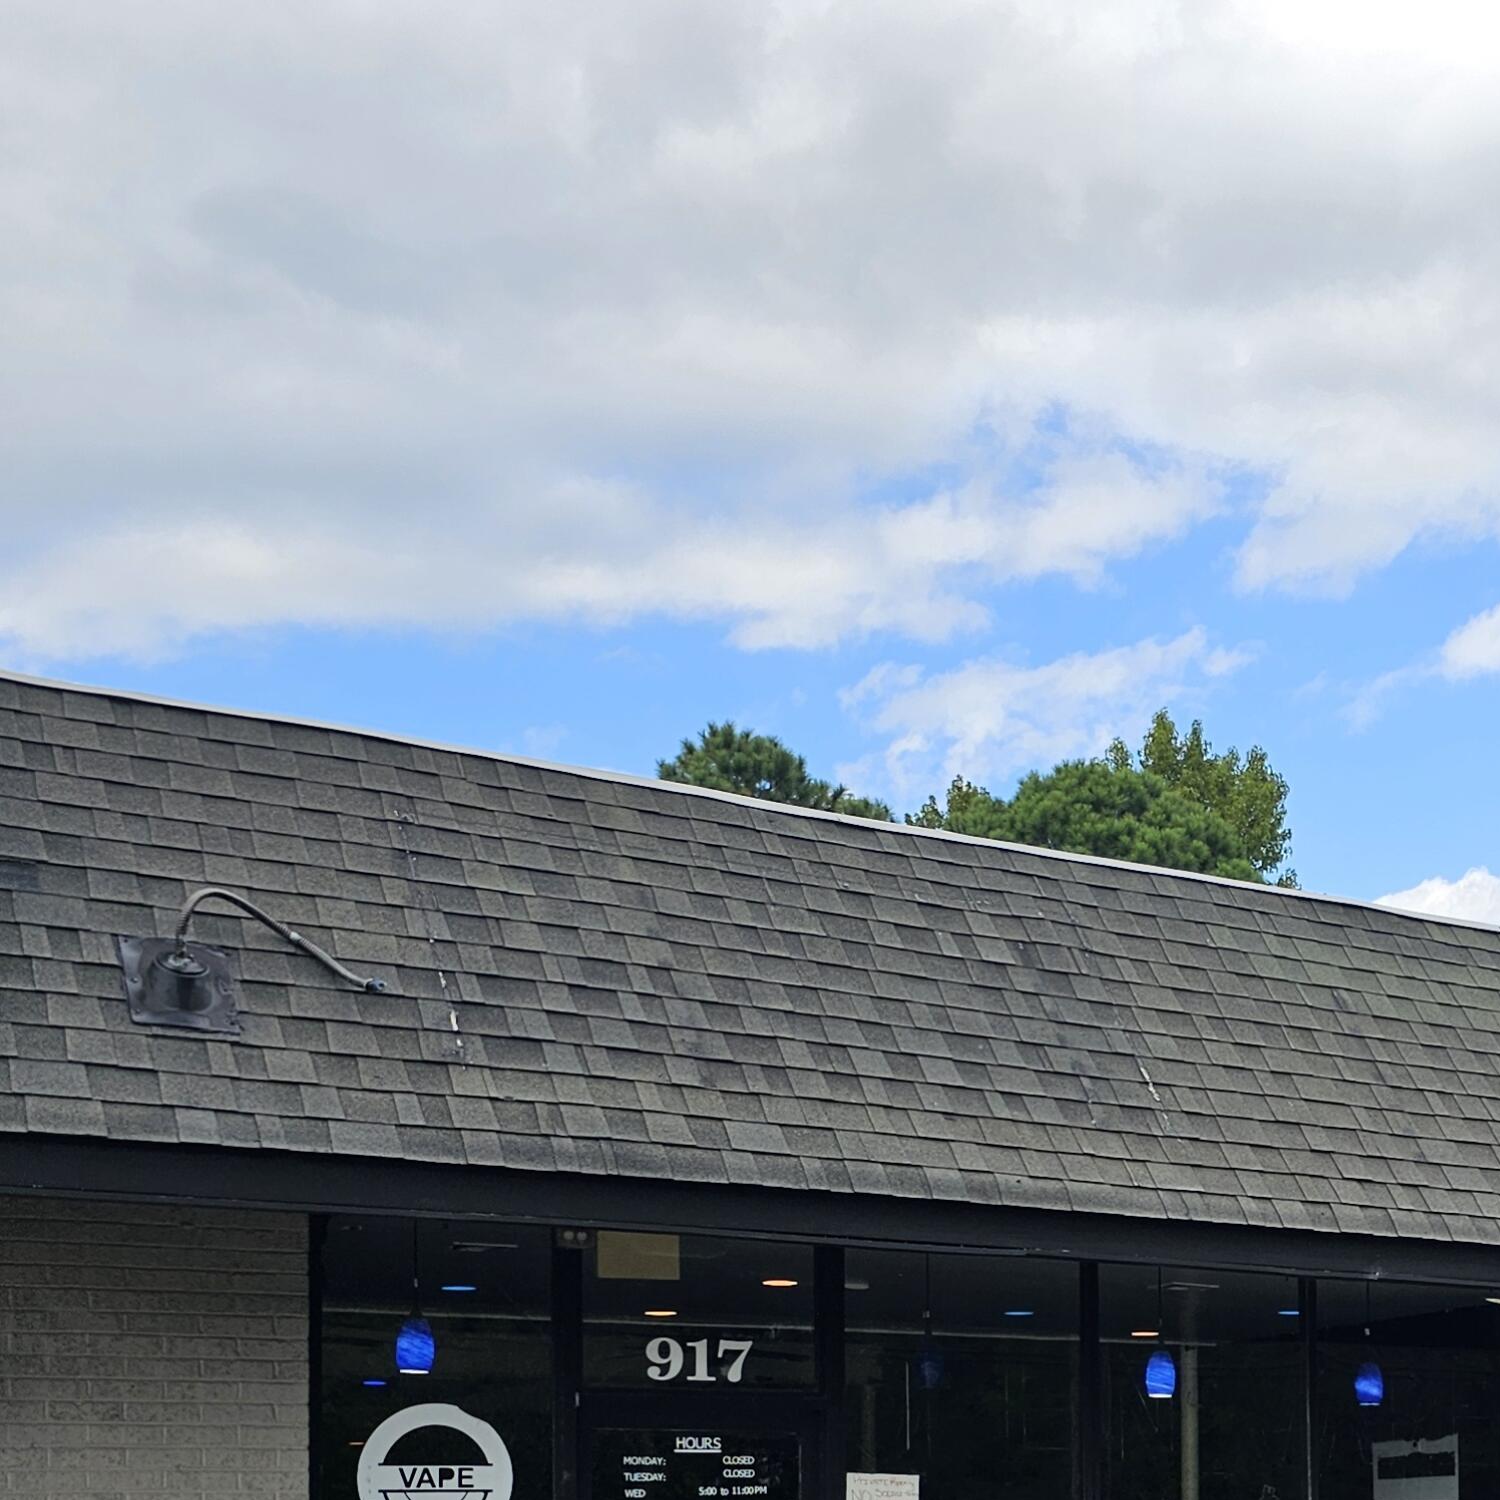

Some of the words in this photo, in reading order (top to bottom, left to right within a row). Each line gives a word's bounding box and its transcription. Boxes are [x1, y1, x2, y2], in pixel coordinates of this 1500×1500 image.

[645, 1336, 753, 1383] 917
[675, 1436, 722, 1450] HOURS
[623, 1456, 667, 1466] MONDAY:
[722, 1455, 755, 1465] CLOSED
[398, 1467, 474, 1488] VAPE
[623, 1472, 667, 1482] TUESDAY:
[722, 1469, 756, 1479] CLOSED
[624, 1489, 646, 1498] WED
[698, 1486, 717, 1496] 5:00
[720, 1487, 729, 1496] to
